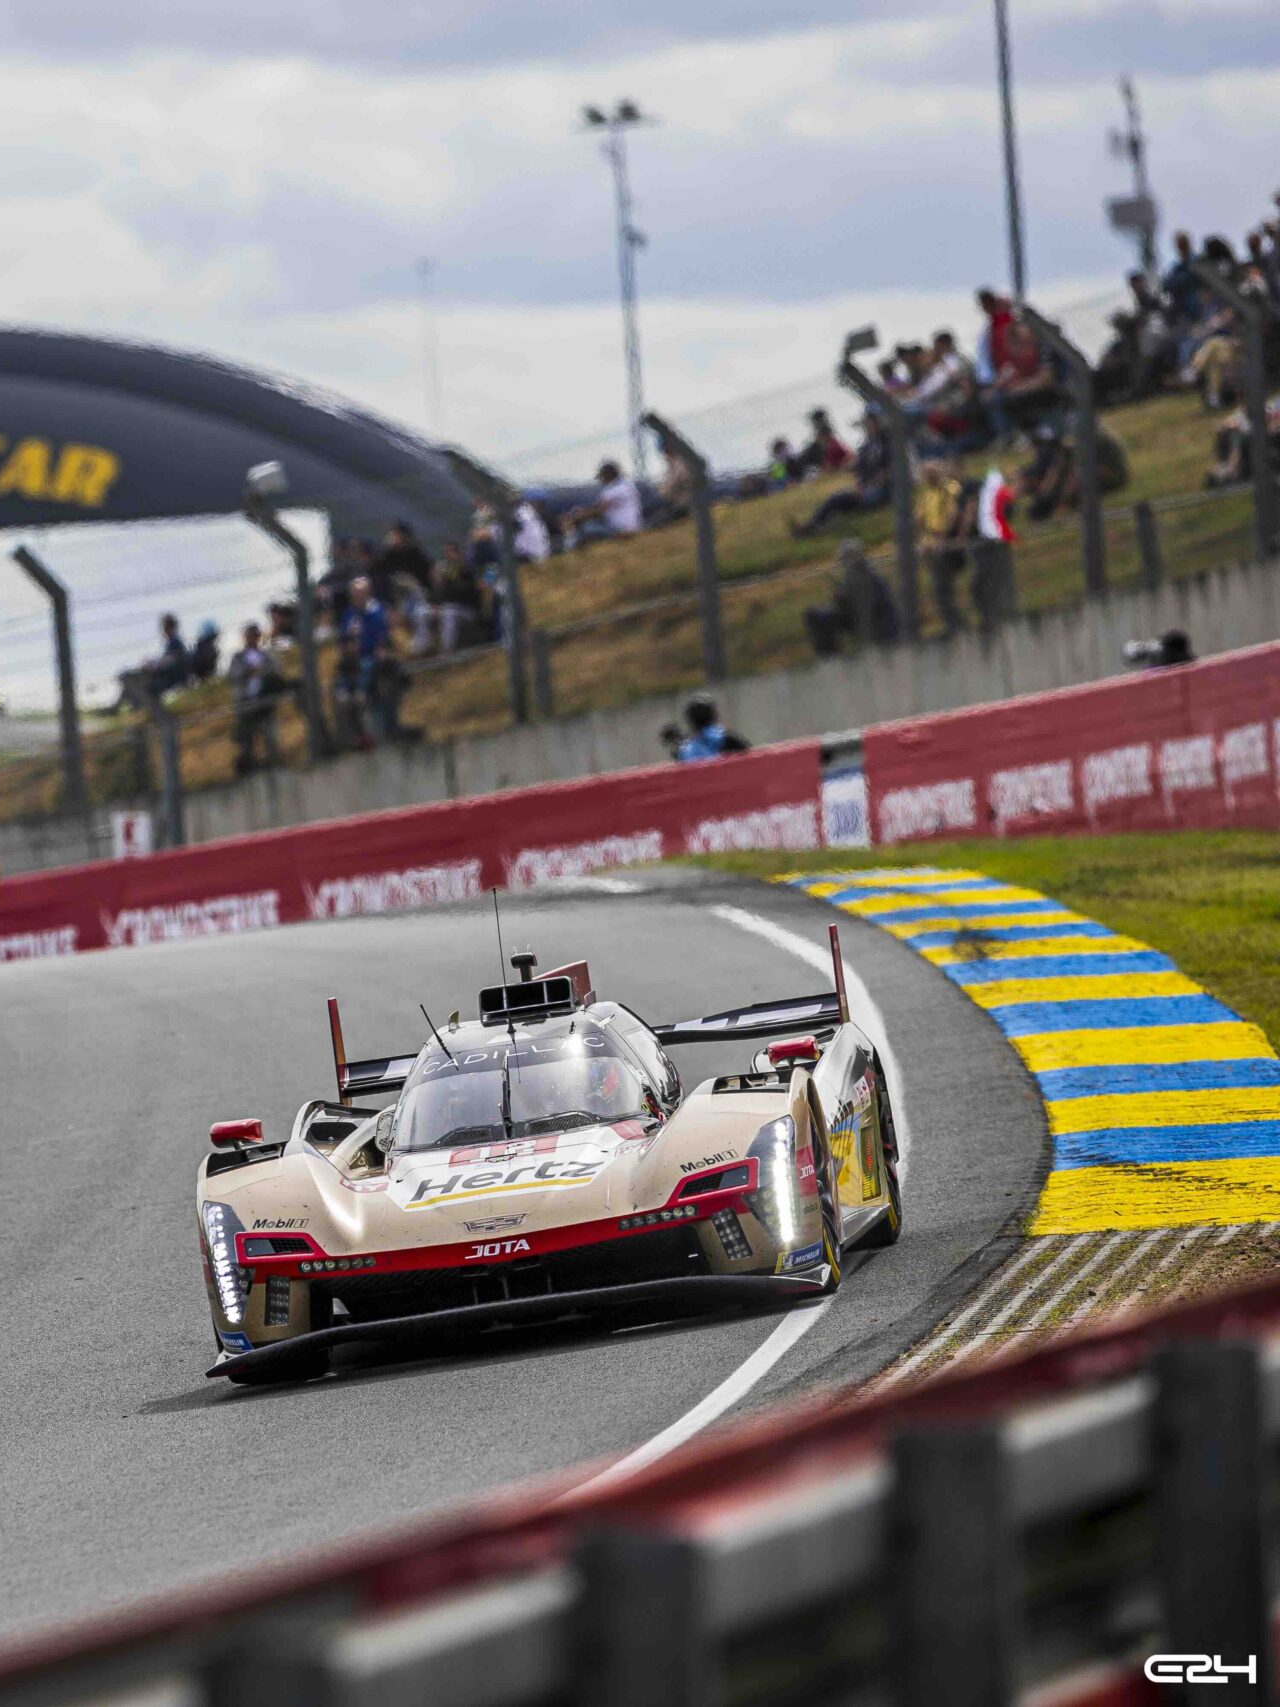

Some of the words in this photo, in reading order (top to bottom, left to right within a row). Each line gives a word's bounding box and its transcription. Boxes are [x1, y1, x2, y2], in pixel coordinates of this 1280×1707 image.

[680, 1153, 724, 1173] Mobil
[409, 1160, 604, 1202] Hertz
[252, 1219, 295, 1230] Mobil
[465, 1239, 531, 1259] JOTA
